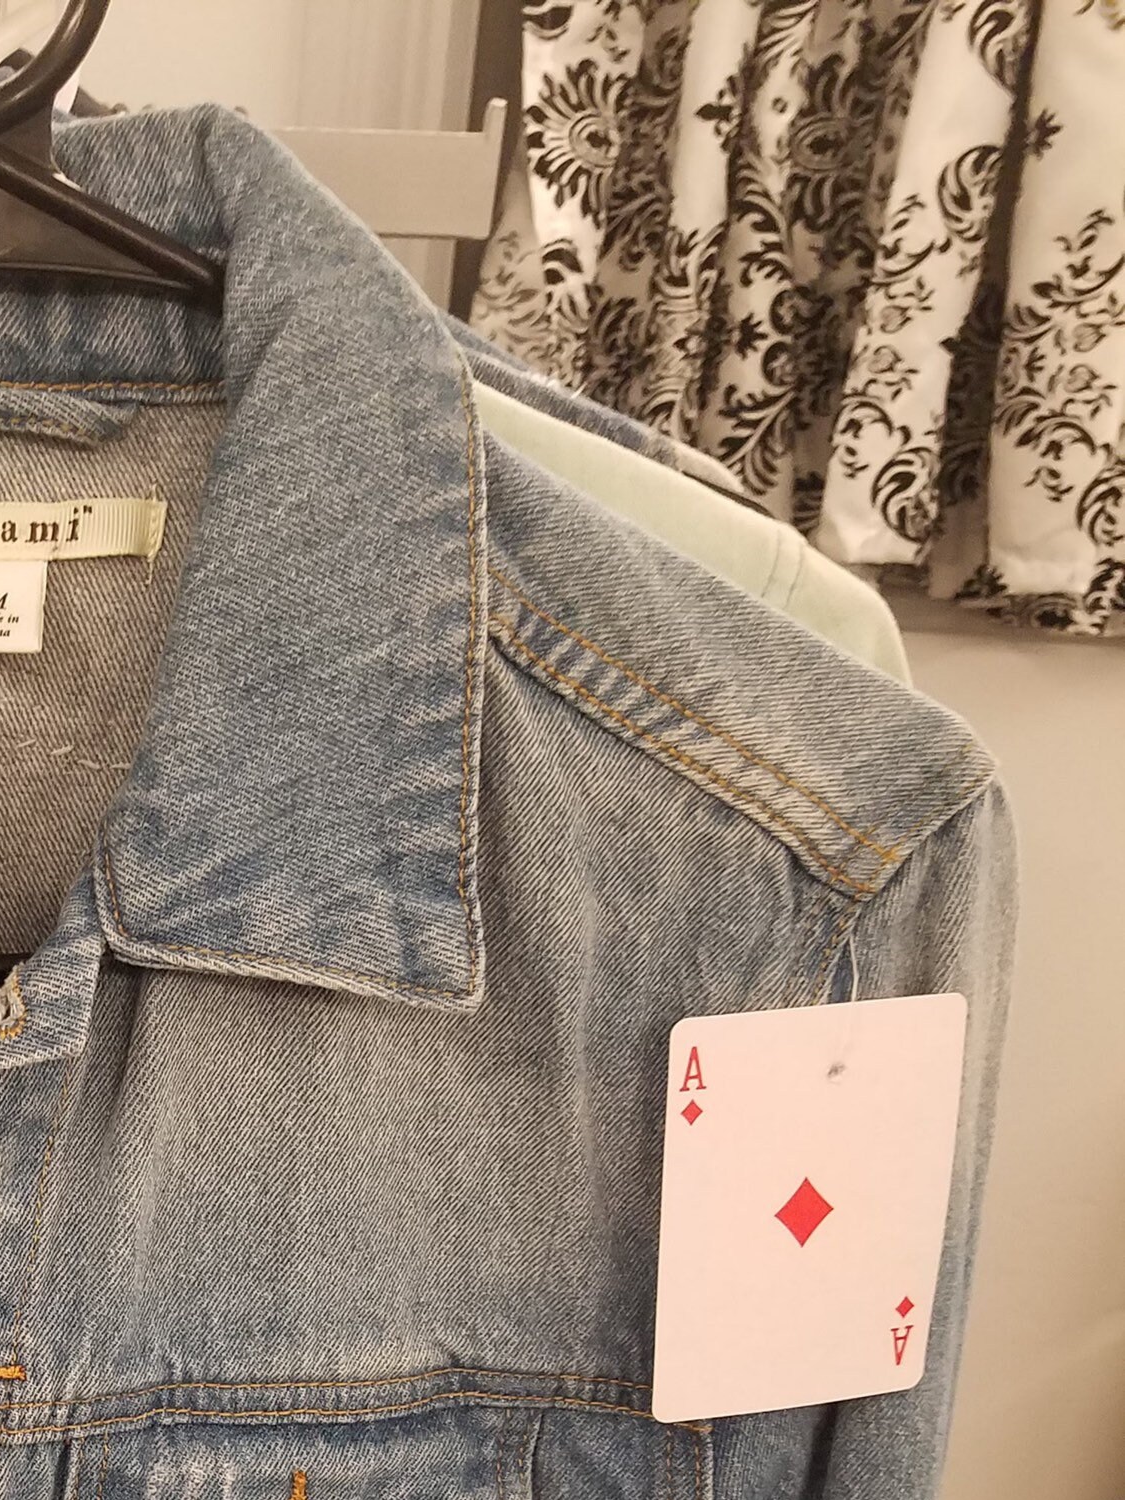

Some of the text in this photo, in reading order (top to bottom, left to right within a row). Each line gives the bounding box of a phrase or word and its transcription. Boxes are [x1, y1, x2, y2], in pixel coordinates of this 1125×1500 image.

[7, 613, 20, 624] in
[679, 1046, 707, 1092] A
[890, 1325, 914, 1366] A
